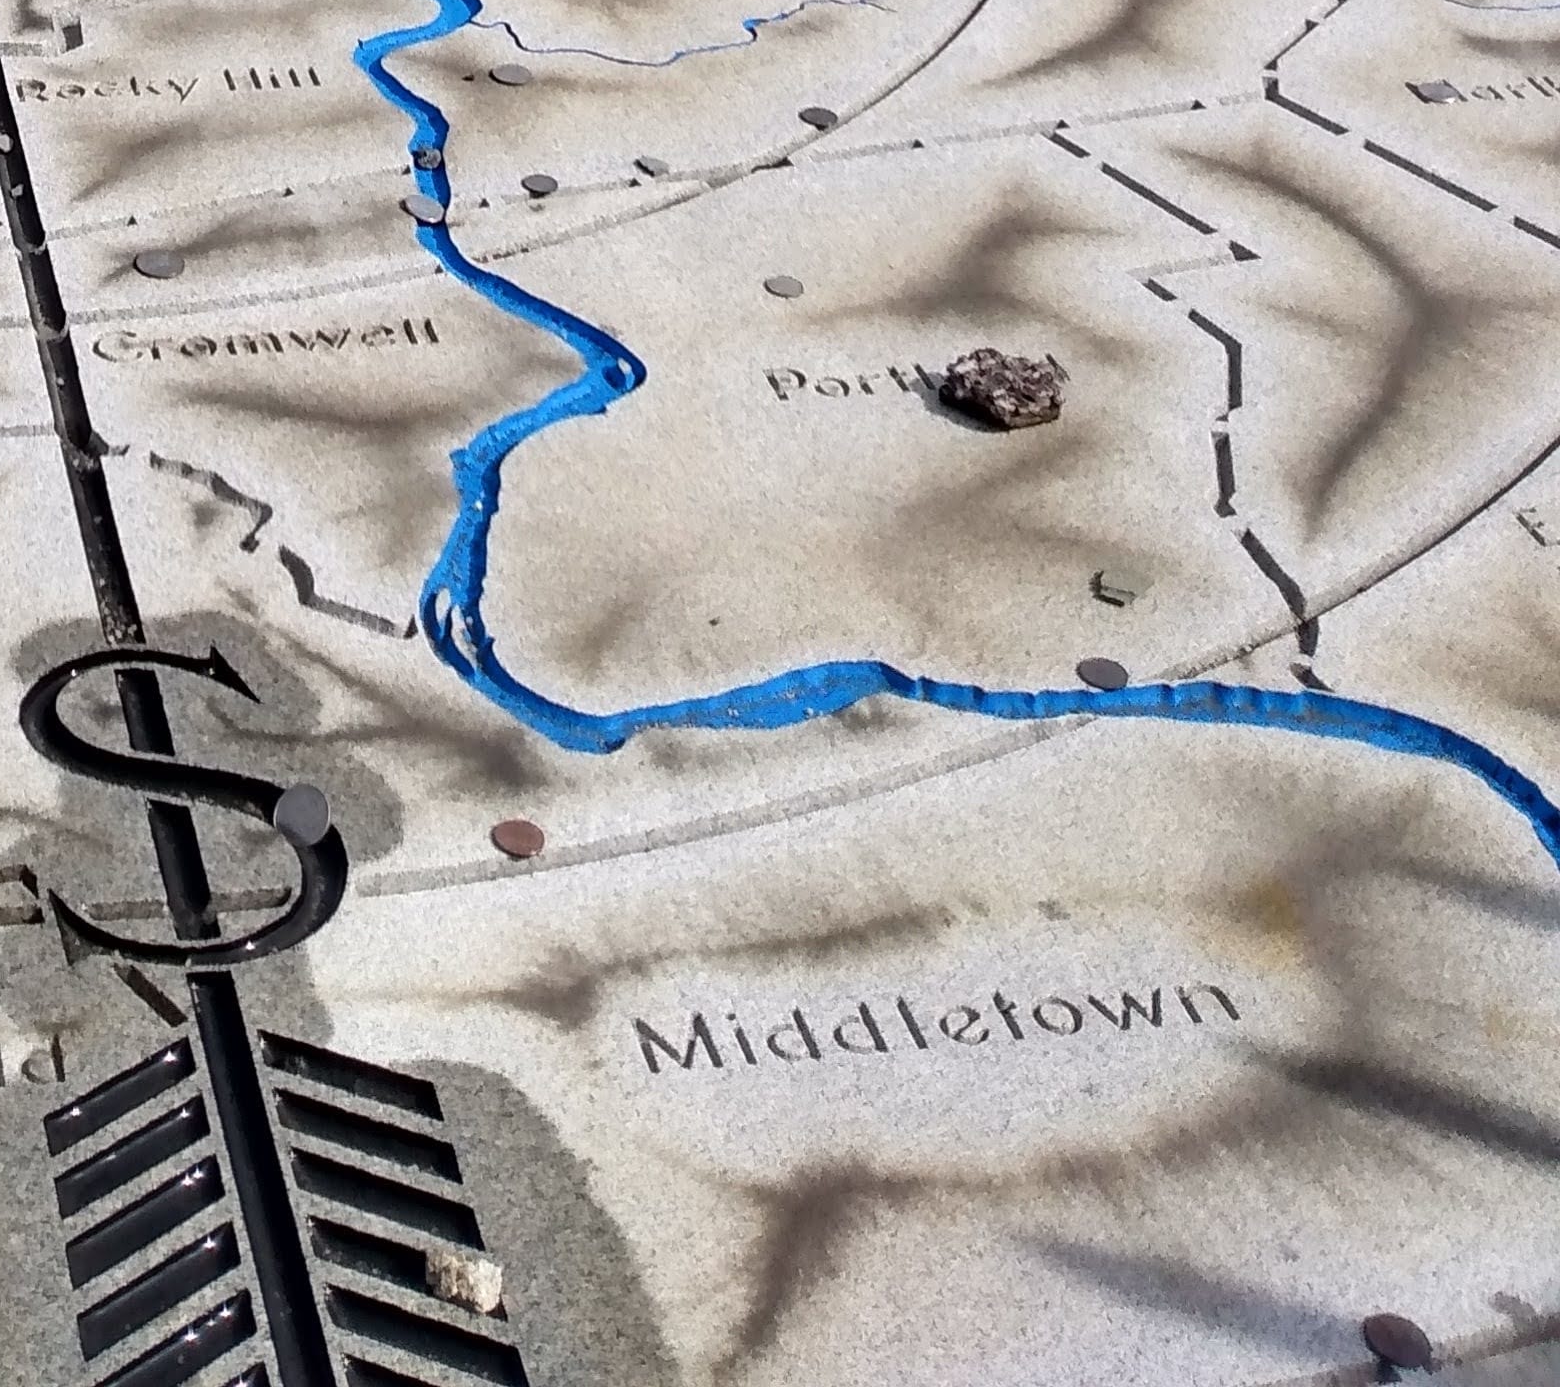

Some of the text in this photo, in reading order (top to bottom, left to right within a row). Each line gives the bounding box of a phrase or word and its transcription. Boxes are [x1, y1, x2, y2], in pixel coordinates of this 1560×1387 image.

[14, 65, 322, 104] Rocky Hill
[634, 982, 1242, 1077] Middletown
